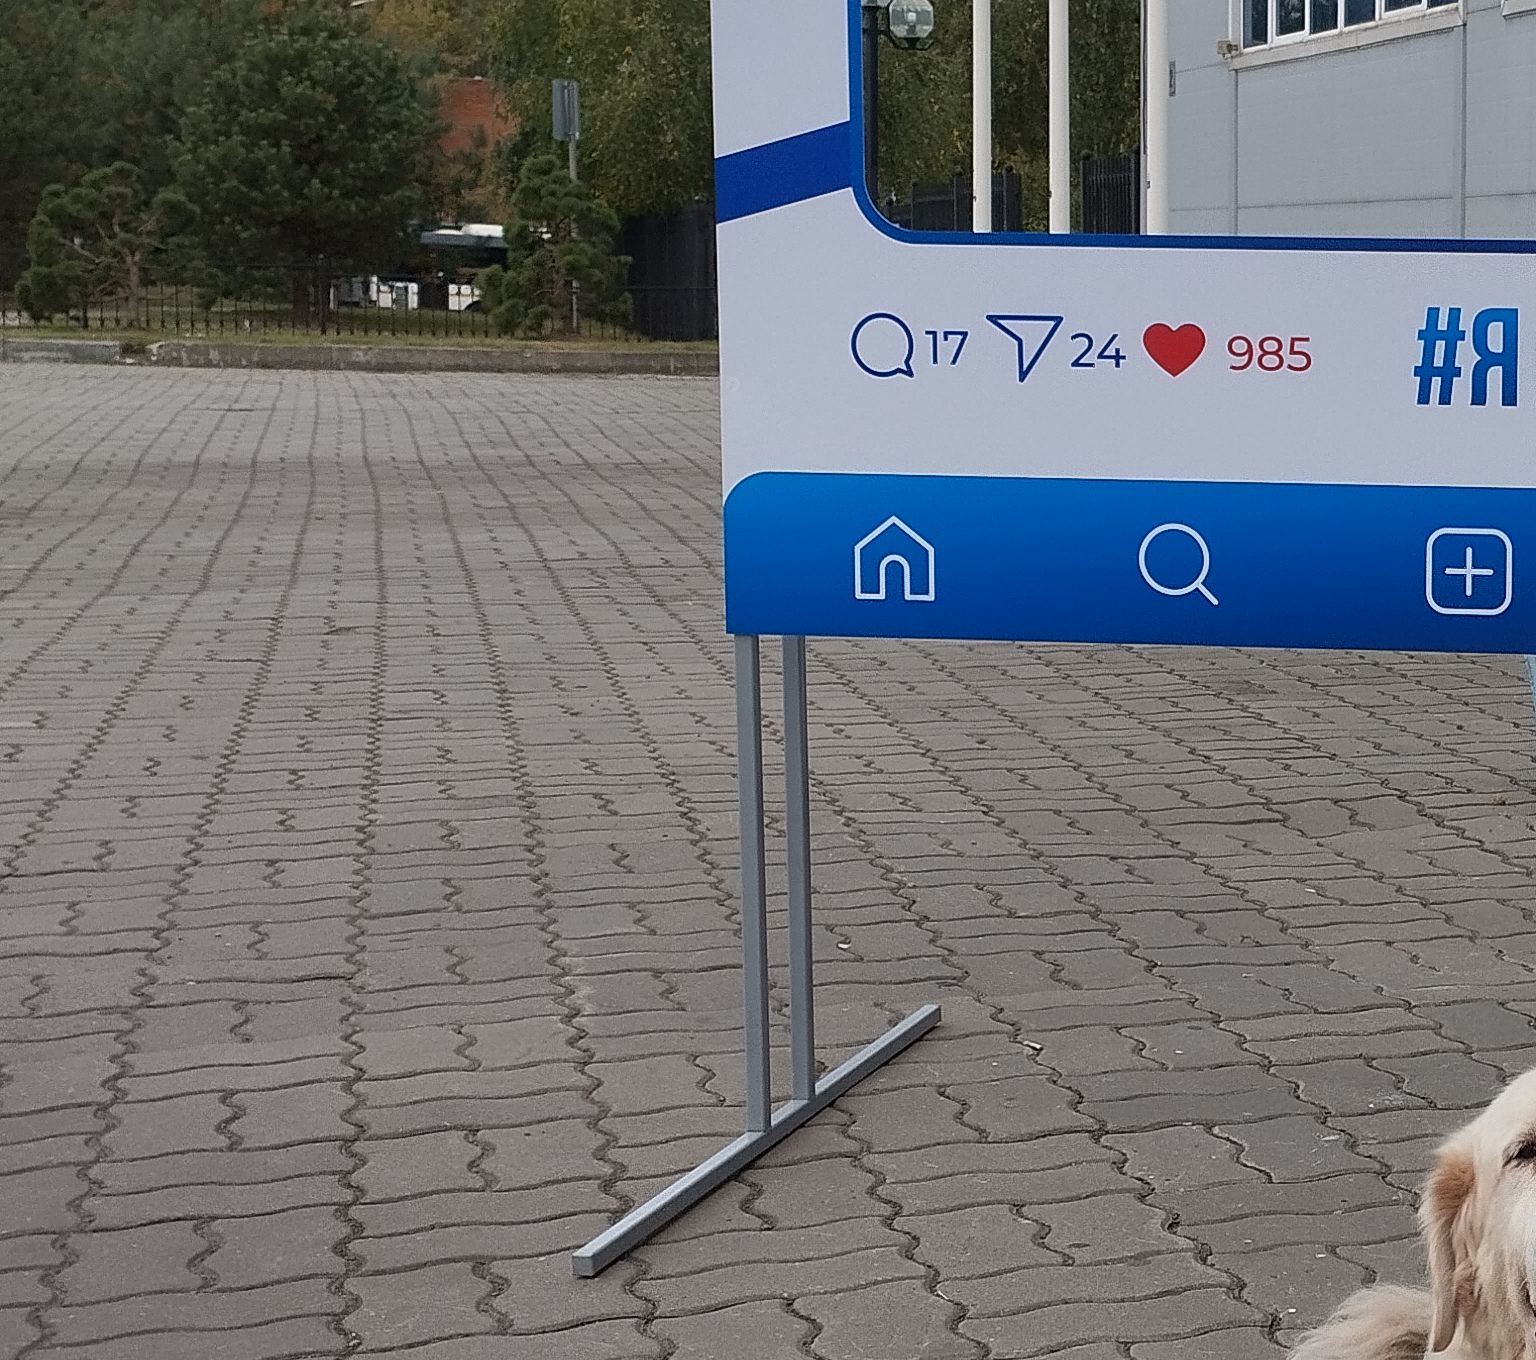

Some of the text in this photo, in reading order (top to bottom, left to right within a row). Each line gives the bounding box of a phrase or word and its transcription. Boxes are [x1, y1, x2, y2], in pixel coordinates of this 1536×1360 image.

[924, 330, 1312, 372] 17 24 985
[1413, 306, 1519, 407] #Я
